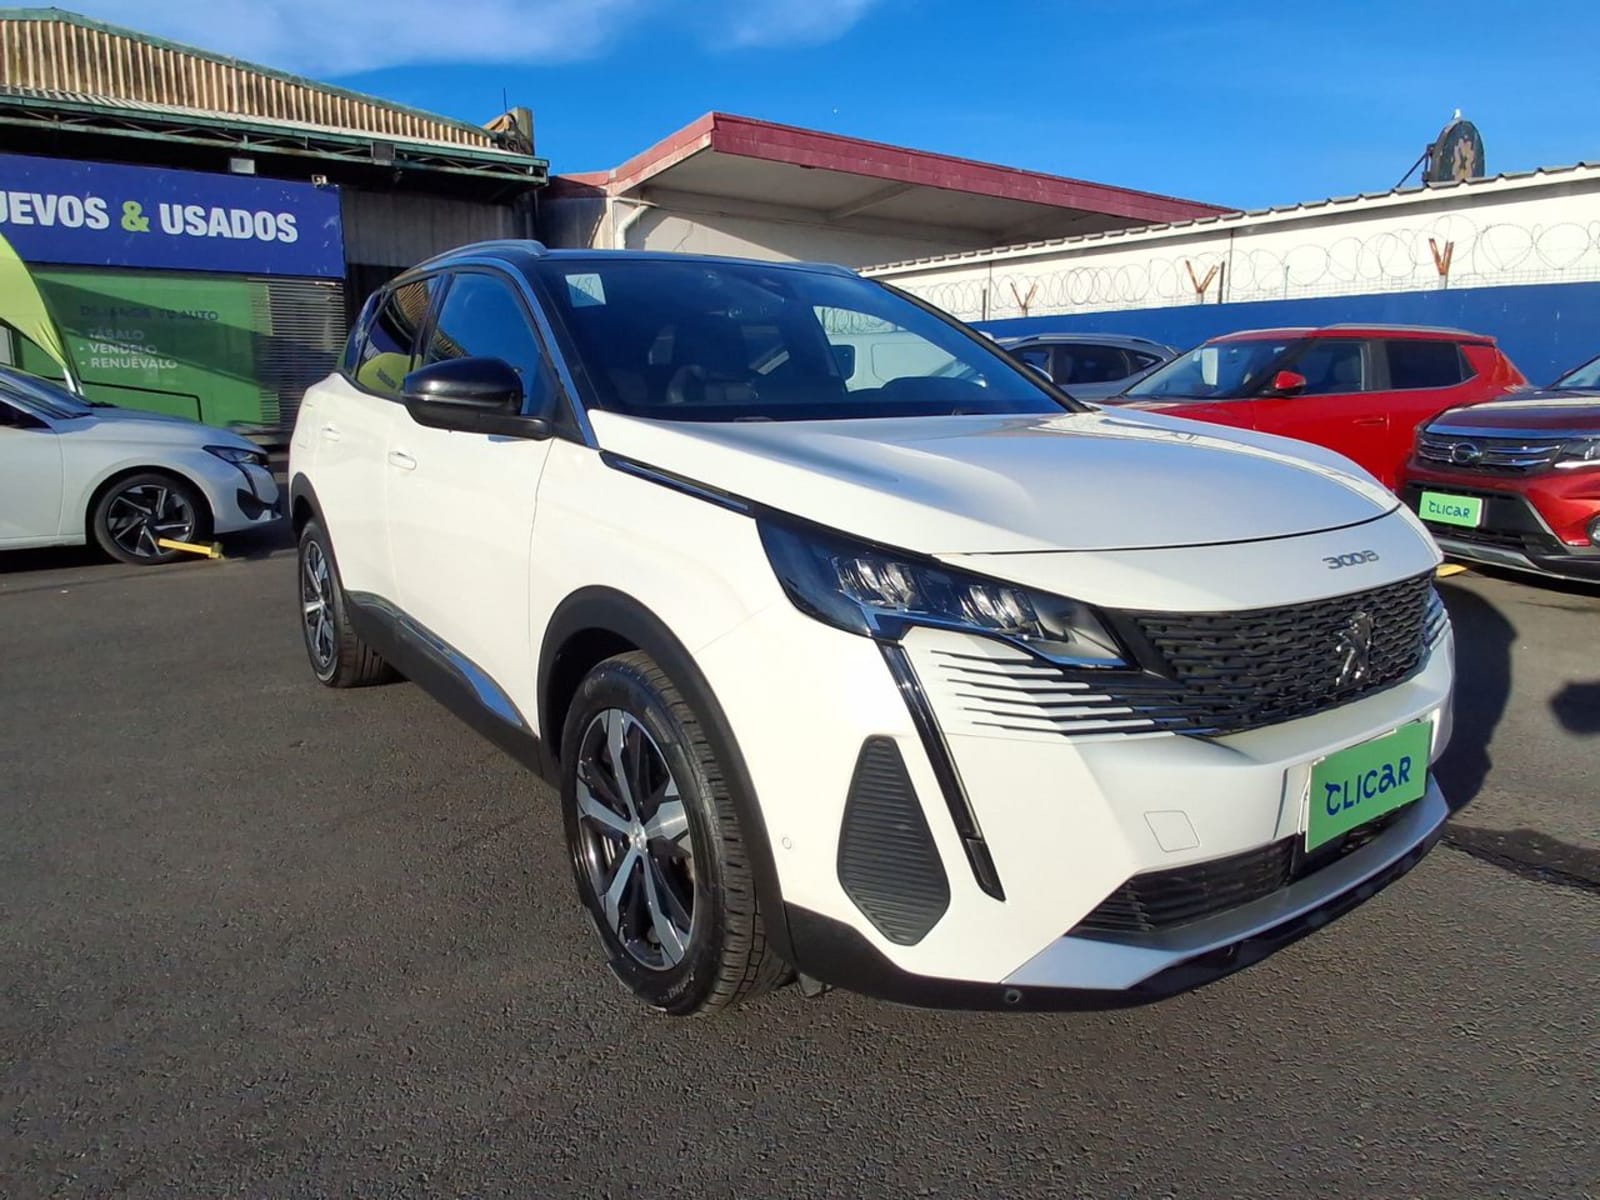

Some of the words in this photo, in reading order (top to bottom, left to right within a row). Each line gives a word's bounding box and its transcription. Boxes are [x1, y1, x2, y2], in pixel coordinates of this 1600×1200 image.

[121, 200, 150, 232] &
[159, 203, 298, 243] USADOS
[1322, 550, 1379, 569] 3008
